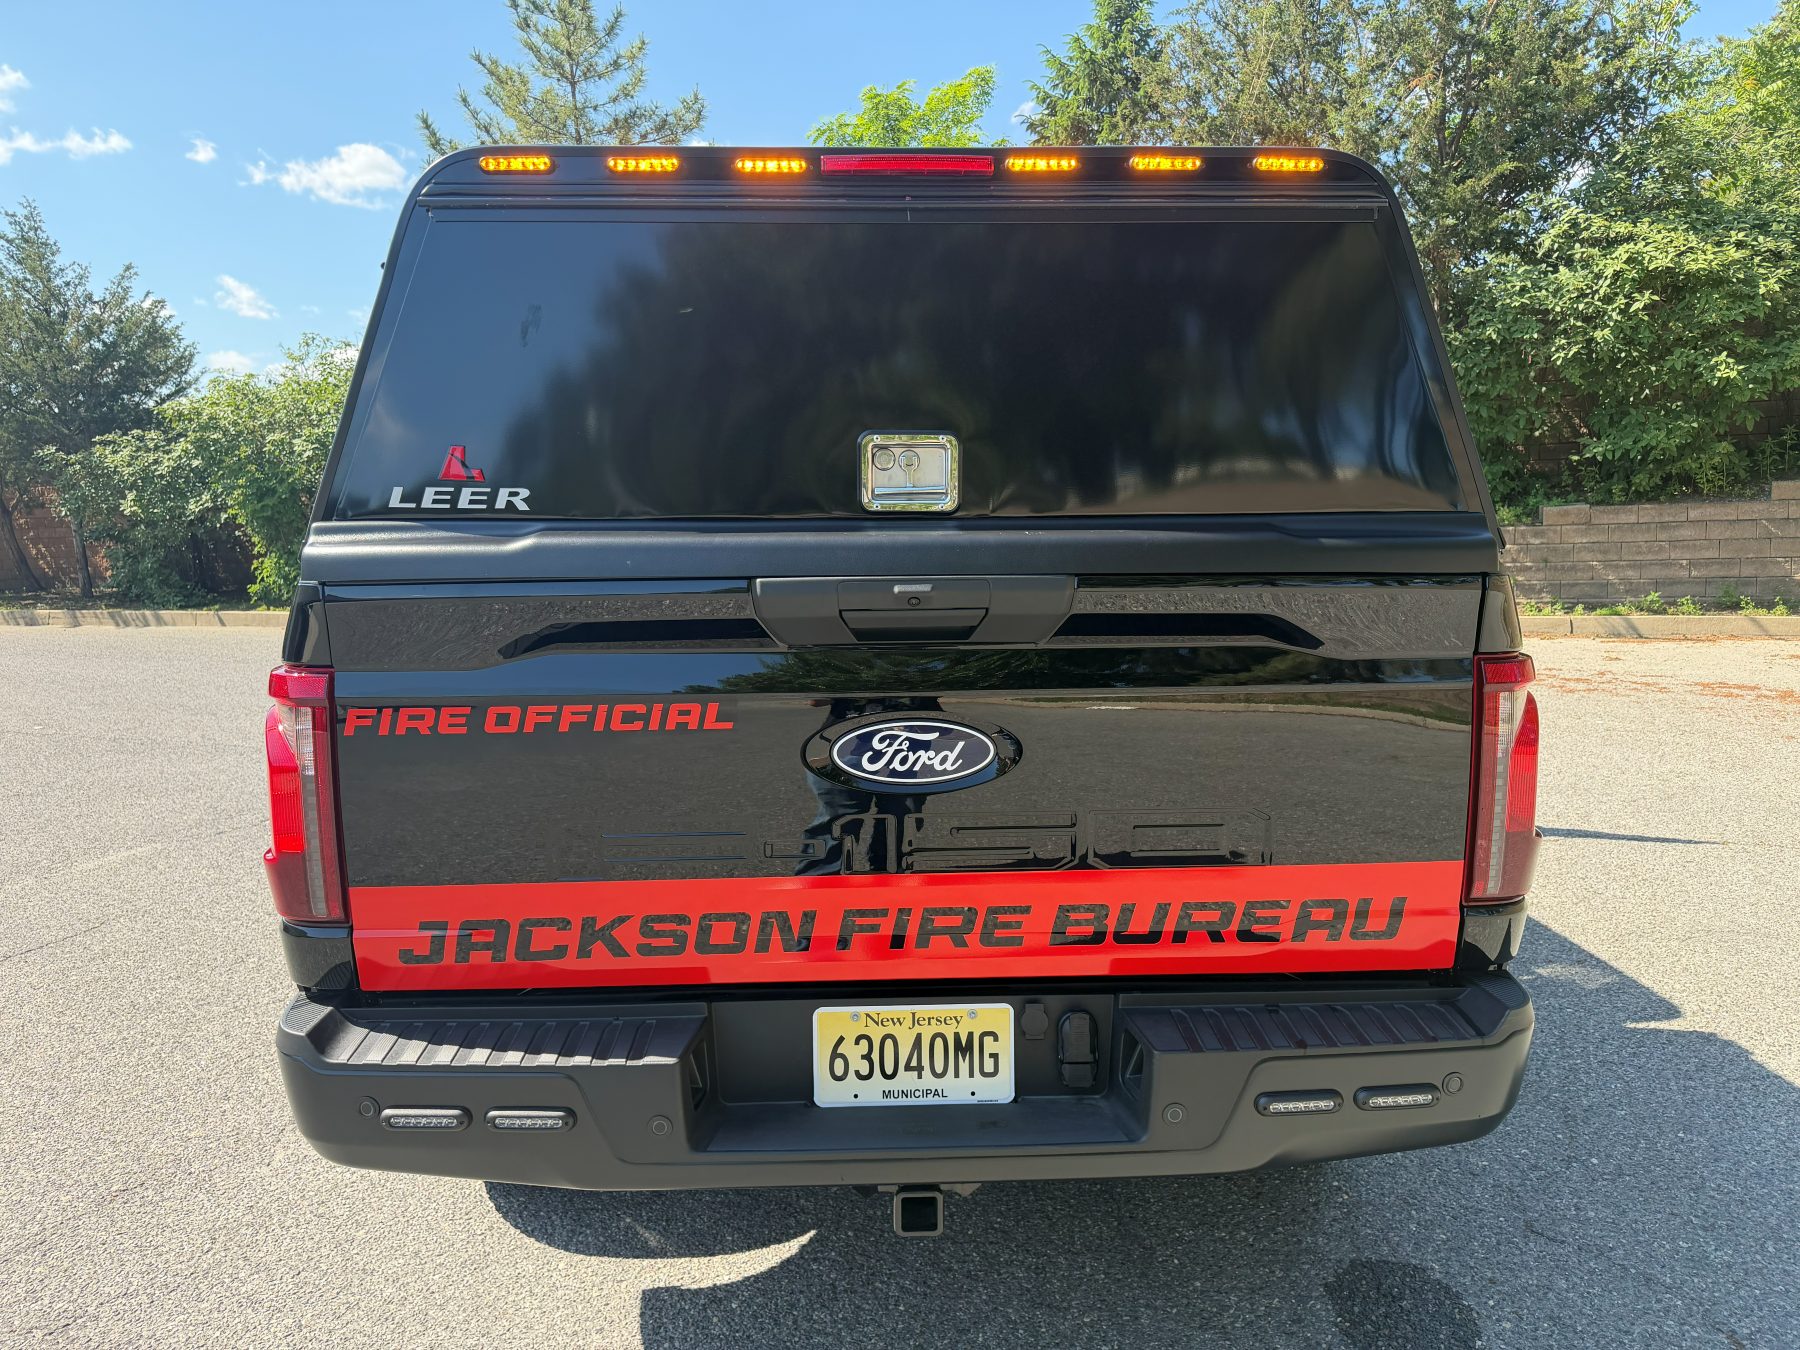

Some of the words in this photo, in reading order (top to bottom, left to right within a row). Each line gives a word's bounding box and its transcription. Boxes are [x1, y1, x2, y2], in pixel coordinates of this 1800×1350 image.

[388, 486, 531, 511] LEER
[343, 706, 472, 736] FIRE
[484, 702, 734, 734] OFFICIAL
[861, 730, 966, 772] Ford
[398, 909, 818, 965] JACKSON
[836, 905, 1032, 951] FIRE
[1048, 896, 1408, 947] BUREAU
[864, 1012, 906, 1028] New
[908, 1011, 963, 1030] Jersey
[828, 1030, 1000, 1082] 63040MG
[882, 1088, 948, 1100] MUNICIPAL
